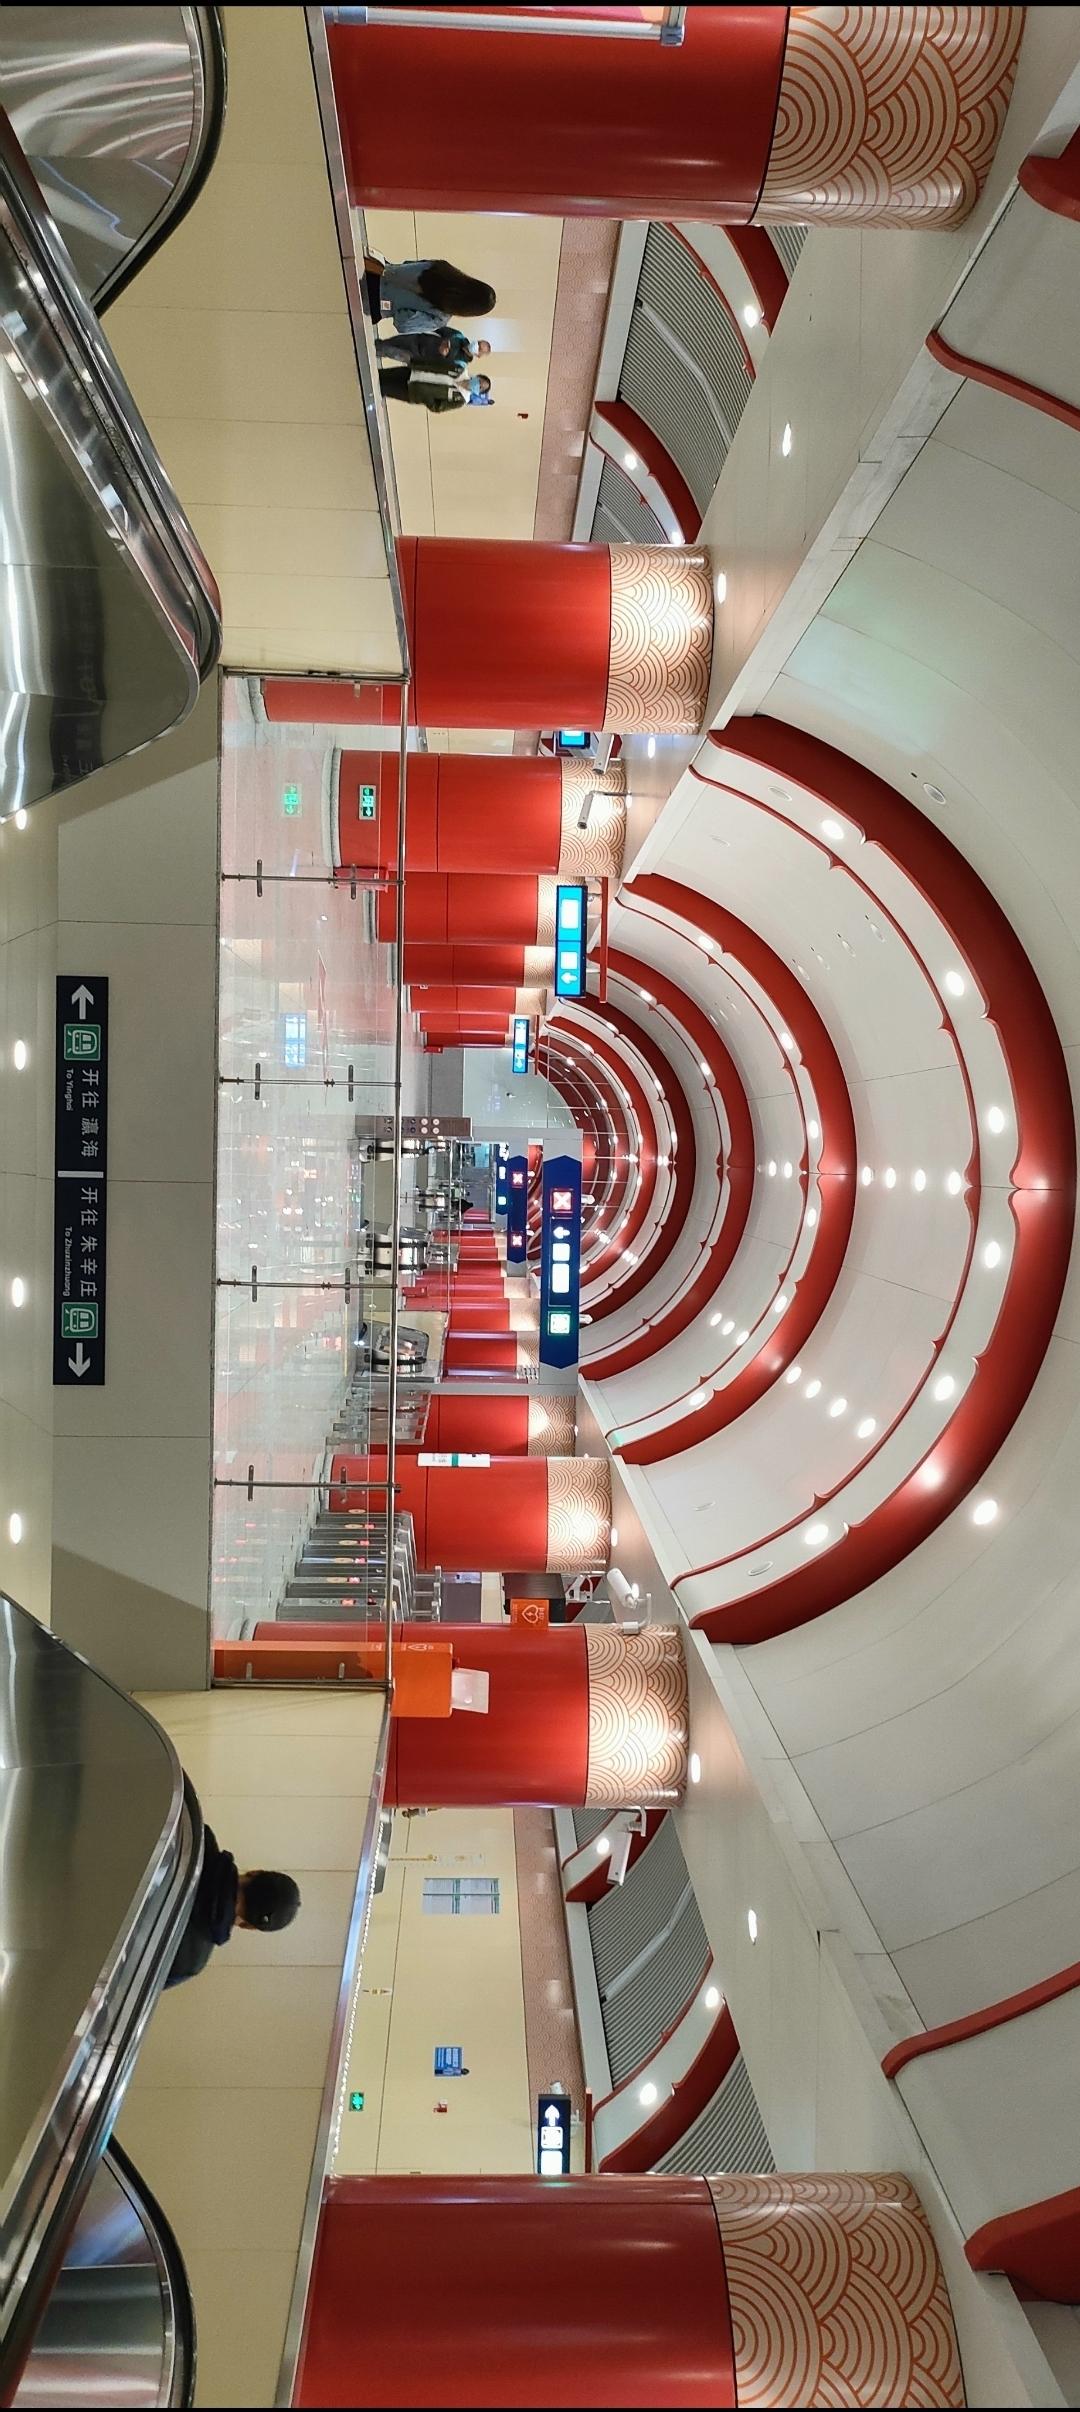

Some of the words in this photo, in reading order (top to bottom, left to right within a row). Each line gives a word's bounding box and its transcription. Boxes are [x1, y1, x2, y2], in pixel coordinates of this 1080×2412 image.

[66, 1068, 74, 1079] To
[82, 1068, 100, 1109] 开往
[64, 1080, 74, 1111] Yinghai
[81, 1117, 99, 1157] 瀛海
[80, 1186, 98, 1226] 开往
[64, 1226, 72, 1237] To
[62, 1238, 72, 1297] Zhuxinzhuang
[80, 1236, 98, 1297] 朱辛庄
